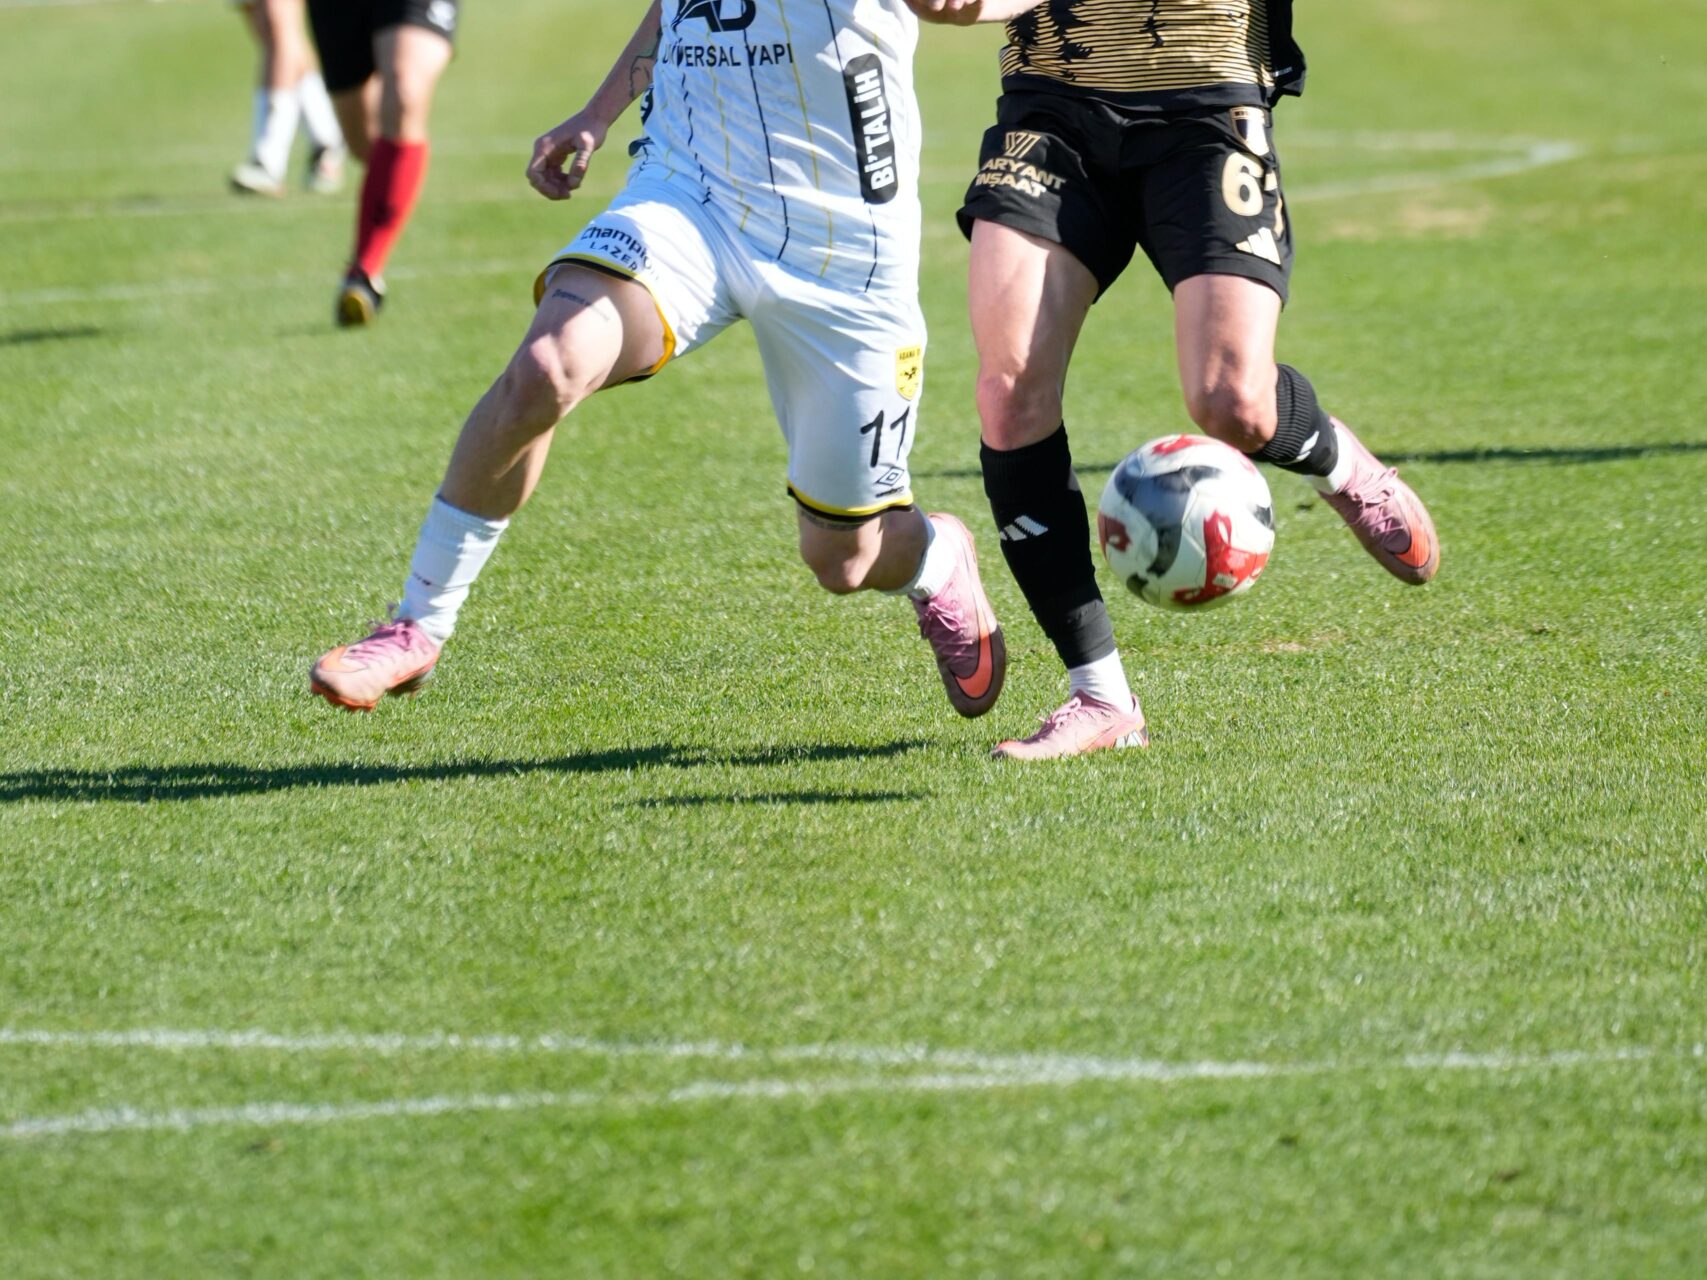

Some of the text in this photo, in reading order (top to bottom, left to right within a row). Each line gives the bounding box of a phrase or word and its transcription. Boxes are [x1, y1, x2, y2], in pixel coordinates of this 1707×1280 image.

[745, 42, 794, 67] YAPI
[980, 158, 1066, 190] ARYANT
[590, 241, 638, 272] LAZER
[860, 406, 910, 468] 11
